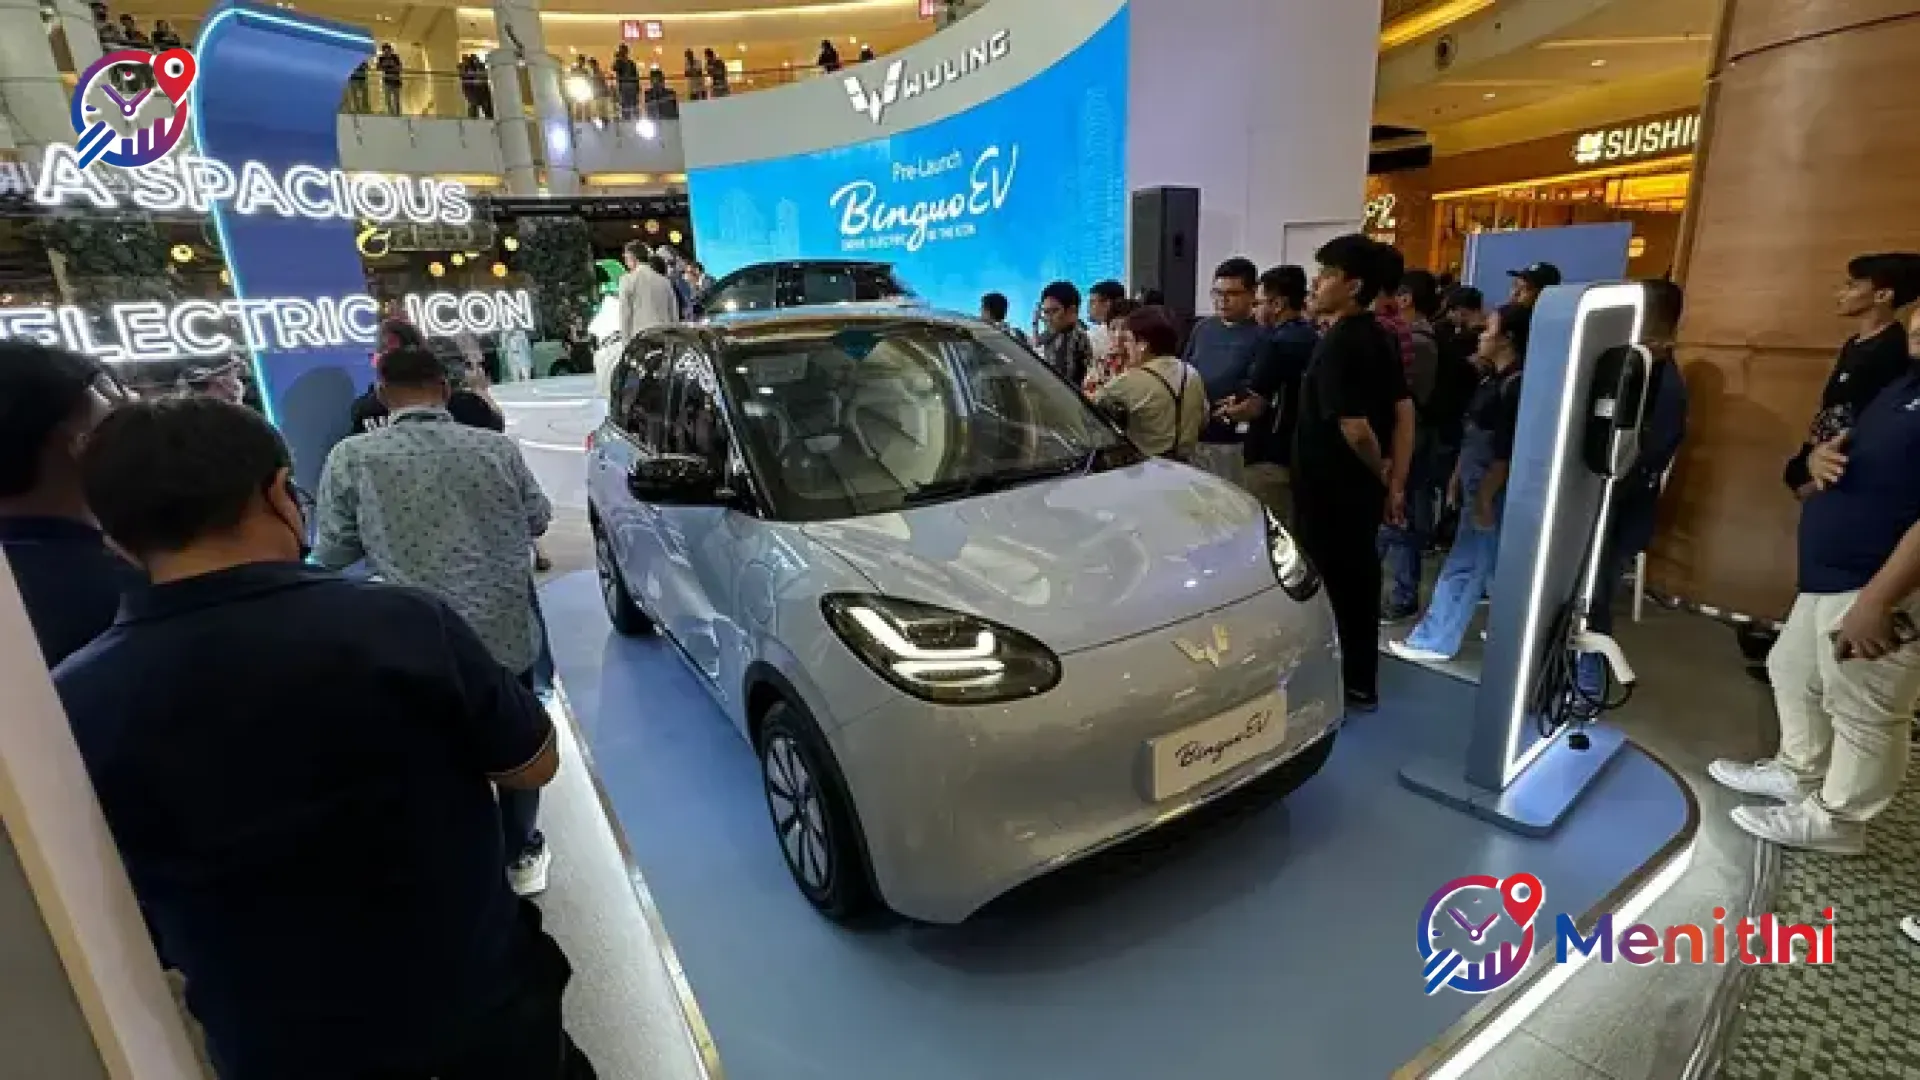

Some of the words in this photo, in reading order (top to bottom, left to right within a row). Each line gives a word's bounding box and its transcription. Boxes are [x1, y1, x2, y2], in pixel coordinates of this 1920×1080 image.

[904, 30, 1010, 97] WULING
[35, 142, 118, 208] A
[132, 154, 473, 223] SPACIOUS
[830, 180, 965, 251] Binguo
[969, 143, 1019, 215] EV
[892, 148, 963, 183] Pre-Launch
[405, 291, 534, 338] ICON
